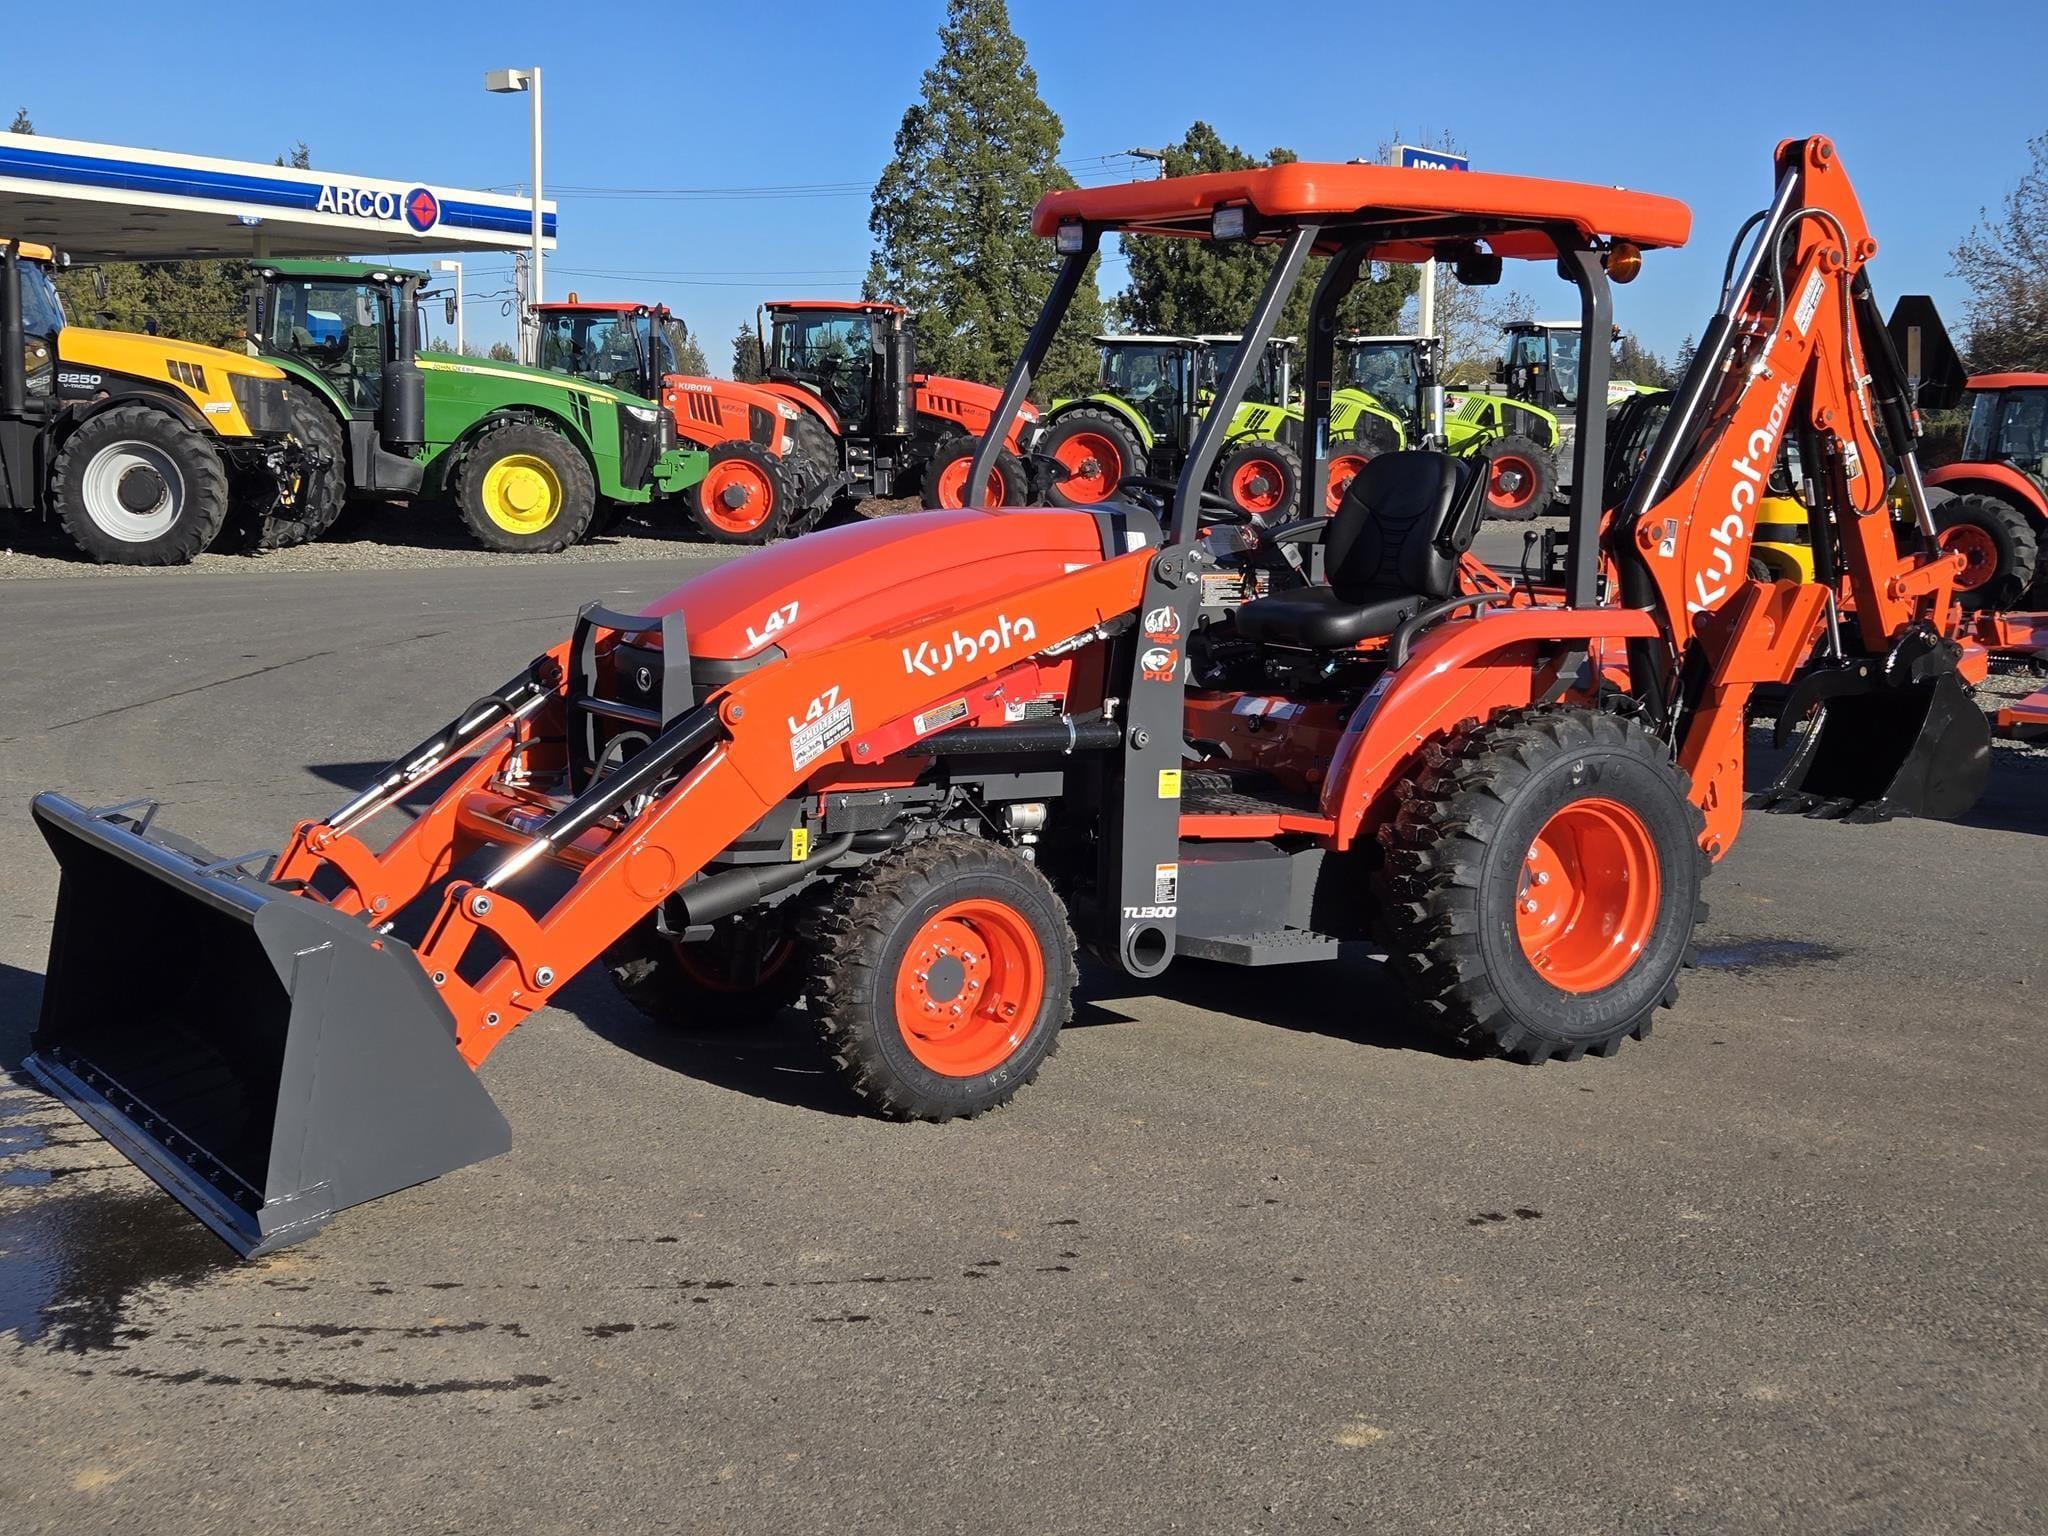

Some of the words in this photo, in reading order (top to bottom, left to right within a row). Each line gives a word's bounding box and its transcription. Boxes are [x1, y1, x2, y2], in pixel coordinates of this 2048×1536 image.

[317, 185, 395, 219] ARCO
[57, 373, 102, 385] 8250
[678, 383, 712, 393] KUBOTA
[1686, 428, 1775, 615] Kubota
[745, 600, 800, 648] L47
[902, 614, 1036, 676] Kubota
[1143, 670, 1174, 682] PTO
[787, 684, 840, 735] L47
[1123, 906, 1178, 919] TL1300
